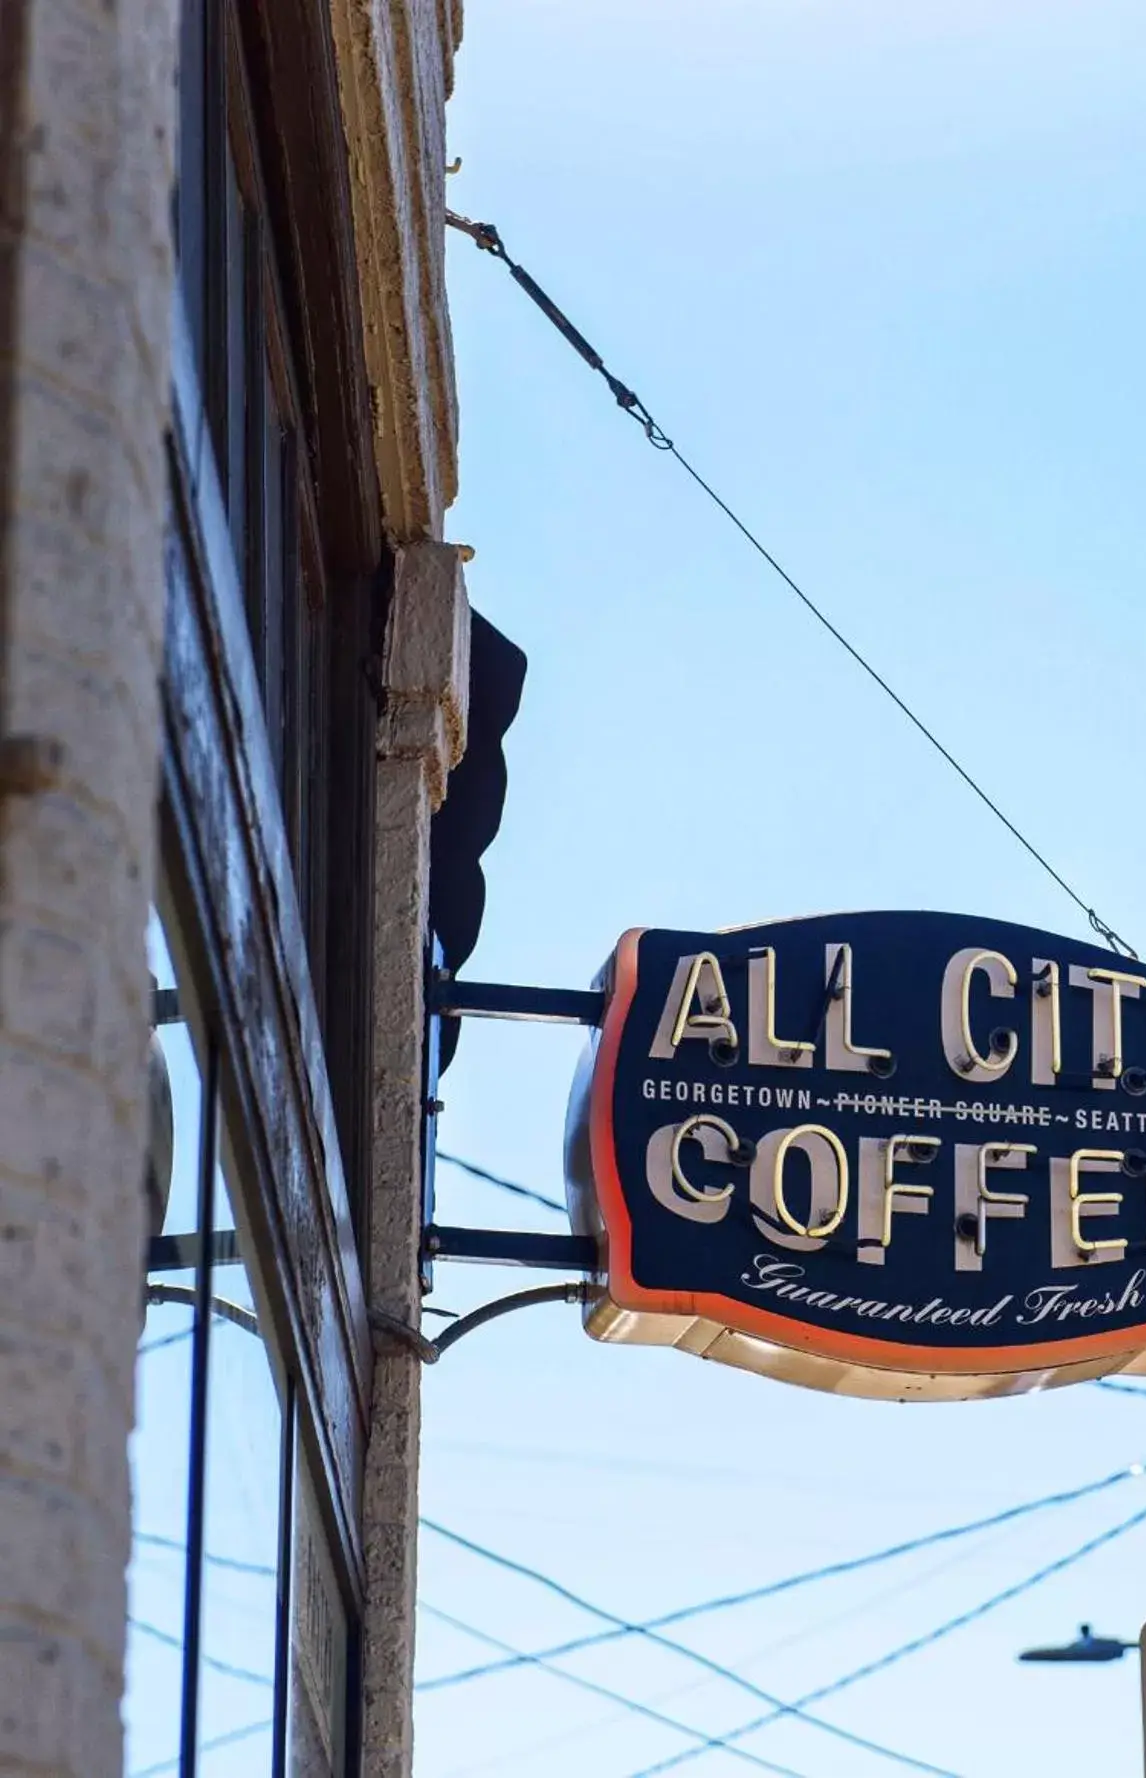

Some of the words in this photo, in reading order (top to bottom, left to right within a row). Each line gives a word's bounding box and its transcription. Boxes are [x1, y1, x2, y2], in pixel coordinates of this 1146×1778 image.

[648, 943, 892, 1072] ALL
[642, 1079, 811, 1110] GEORGETOWN
[741, 1254, 1014, 1326] Guaranteed
[1016, 1268, 1146, 1325] Fresh
